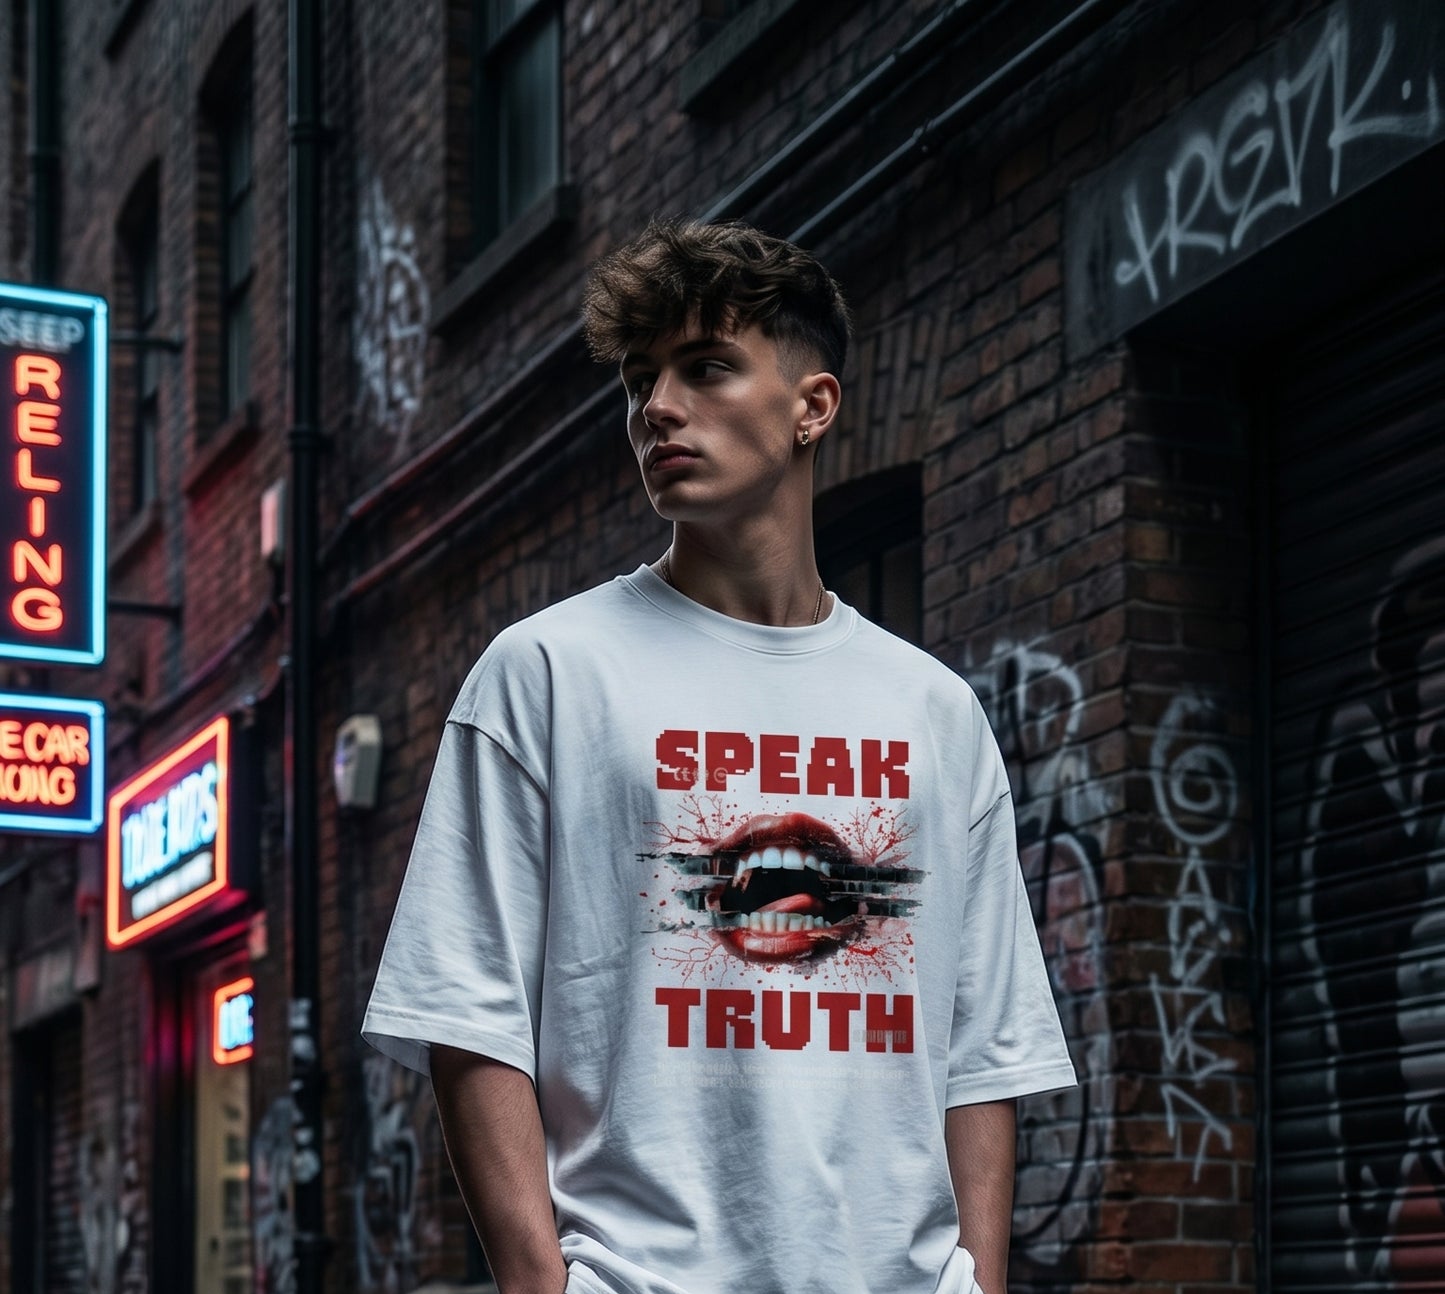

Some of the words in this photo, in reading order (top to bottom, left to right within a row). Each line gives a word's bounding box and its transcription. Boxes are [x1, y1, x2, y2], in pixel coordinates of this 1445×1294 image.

[11, 354, 63, 632] RELING
[656, 730, 910, 799] SPEAK
[655, 987, 914, 1054] TRUTH
